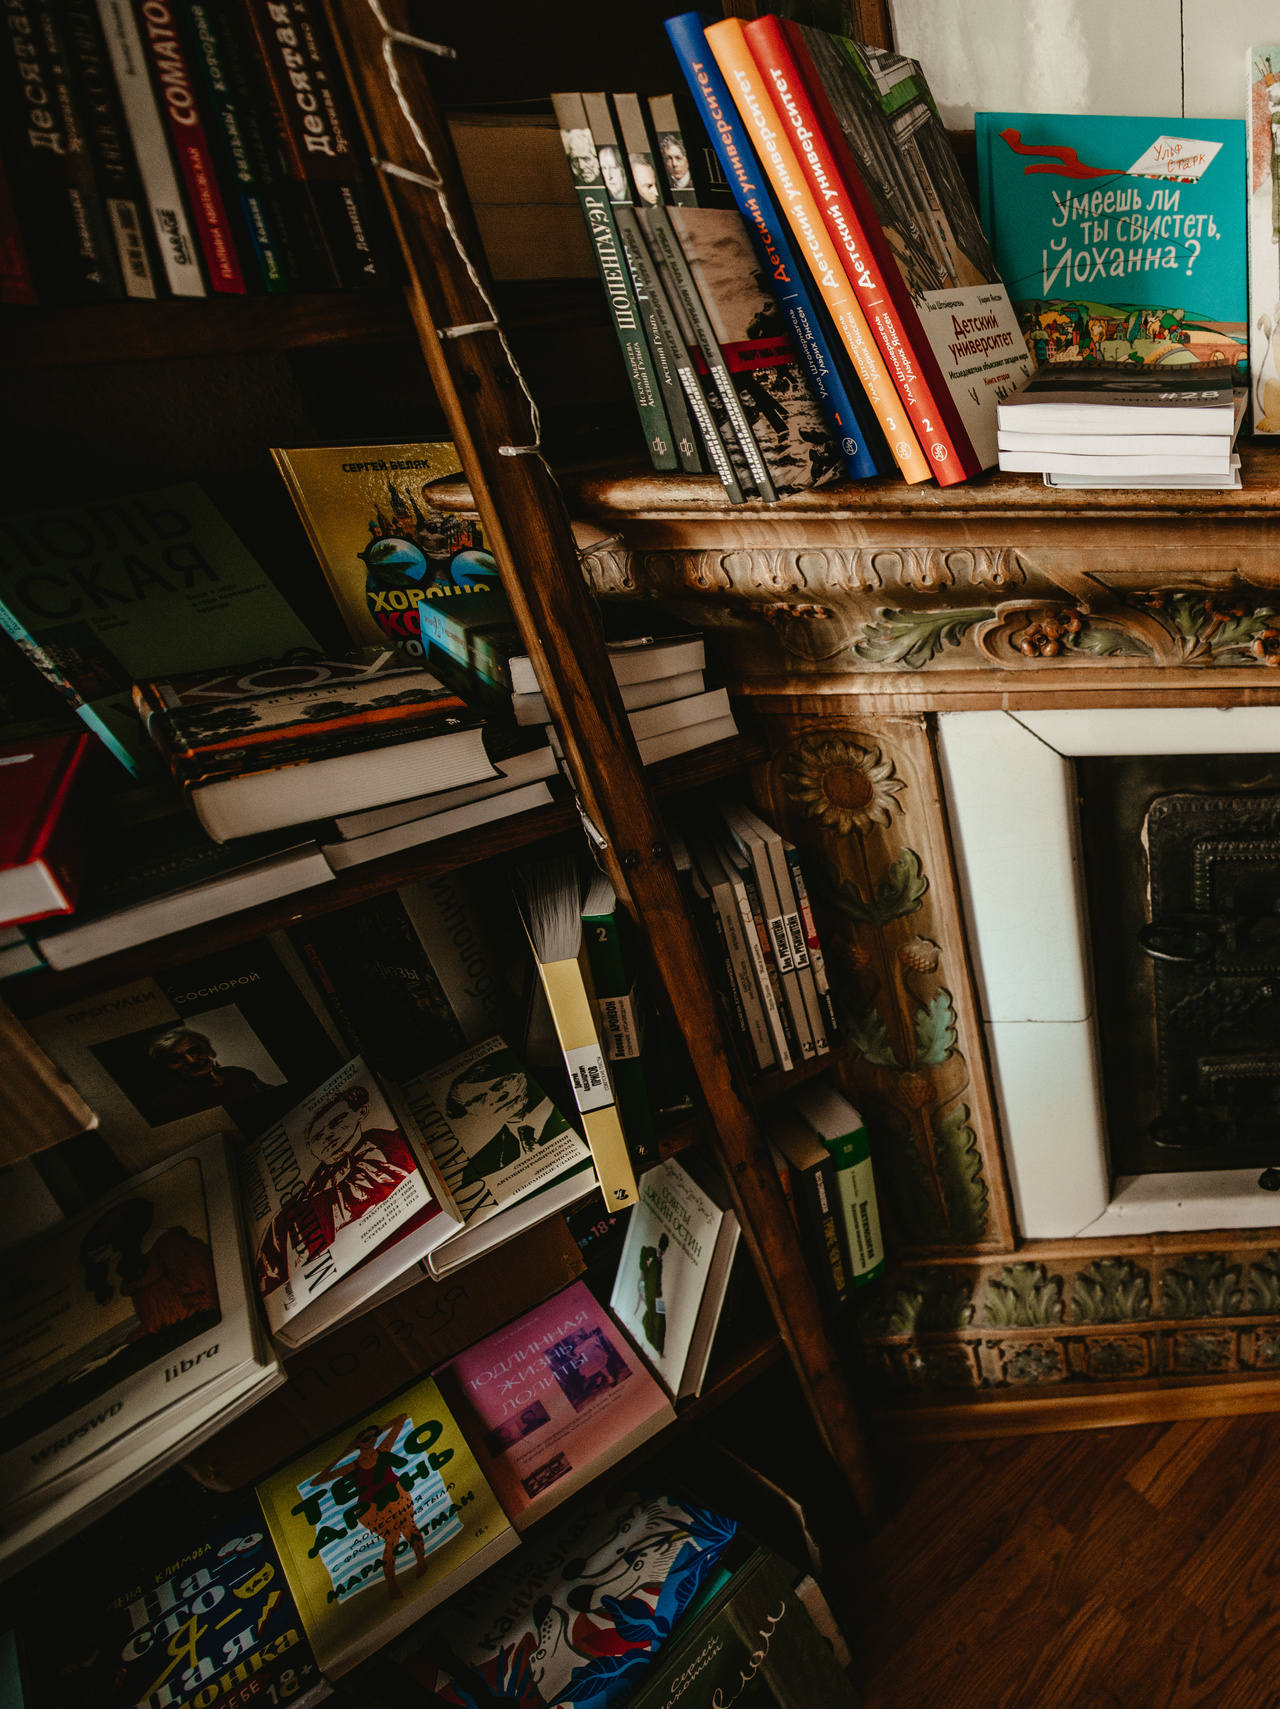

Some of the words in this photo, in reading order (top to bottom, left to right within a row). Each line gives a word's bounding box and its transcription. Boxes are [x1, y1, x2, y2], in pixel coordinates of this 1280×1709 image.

[267, 0, 336, 157] Десятая
[691, 60, 757, 194] университет
[733, 68, 801, 200] университет
[770, 67, 838, 201] университет
[1153, 144, 1183, 162] Ульф
[1167, 154, 1206, 173] Старк
[1051, 188, 1142, 227] Умеешь
[1146, 189, 1181, 212] ли
[155, 208, 187, 266] GARAGE
[656, 227, 674, 258] РОБЕРТ
[746, 196, 791, 283] Детский
[790, 203, 841, 290] Детский
[827, 204, 876, 290] Детский
[1080, 218, 1109, 245] ты
[1116, 213, 1222, 245] свистеть,
[585, 197, 637, 331] ШОПЕНГАУЭР
[1043, 236, 1202, 297] Йоханна?
[789, 309, 817, 375] Штойернагель
[796, 306, 815, 340] Янссен
[845, 311, 865, 346] Янссен
[881, 312, 902, 346] Янссен
[951, 310, 999, 341] Детский
[810, 340, 829, 377] Ульрих
[838, 314, 868, 381] Штойернагель
[861, 346, 880, 382] Ульрих
[874, 315, 904, 382] Штойернагель
[897, 347, 917, 382] Ульрих
[948, 330, 1014, 364] университет
[815, 374, 829, 398] Улла
[866, 380, 880, 404] Улла
[949, 366, 983, 380] Исследователи
[983, 377, 997, 386] Книга
[997, 374, 1010, 382] вторая
[902, 381, 917, 406] Улла
[1158, 390, 1221, 400] #28
[834, 412, 843, 426] 1
[885, 416, 896, 431] 3
[922, 418, 934, 433] 2
[342, 459, 388, 473] СЕРГЕЙ
[390, 459, 431, 470] БЕЛЯК
[15, 541, 220, 619] СКАЯ
[597, 927, 608, 942] 2
[771, 920, 790, 962] РУБИНШТЕЙН
[787, 915, 806, 958] РУБИНШТЕЙН
[174, 971, 262, 1004] СОСНОРОЙ
[66, 990, 157, 1025] ПРОГУЛКИ
[513, 1134, 570, 1170] СТИХОТВОРЕНИЯ
[260, 1118, 338, 1294] МАЯКОВСКИЙ
[358, 1179, 413, 1227] СТИХОТВОРЕНИЯ
[661, 1186, 691, 1226] СОВЕТЫ
[590, 1217, 617, 1237] 18+
[669, 1217, 702, 1257] ОСТИН
[164, 1343, 220, 1382] libra
[496, 1344, 574, 1396] ЖИЗНЬ
[501, 1353, 589, 1416] ЛОЛИТЫ
[291, 1419, 444, 1526] ТЕЛО
[305, 1447, 455, 1559] ДРЯНЬ
[350, 1494, 423, 1550] ДОНЕСЕНИЯ
[343, 1529, 391, 1564] ФРОНТА
[424, 1482, 456, 1507] ТЫЛА)
[474, 1525, 489, 1539] 18+
[154, 1541, 212, 1585] КЛИМОВА
[326, 1558, 387, 1604] МАРА
[391, 1490, 475, 1556] ОЛТМАН
[122, 1568, 220, 1638] На
[265, 1664, 313, 1706] 18+
